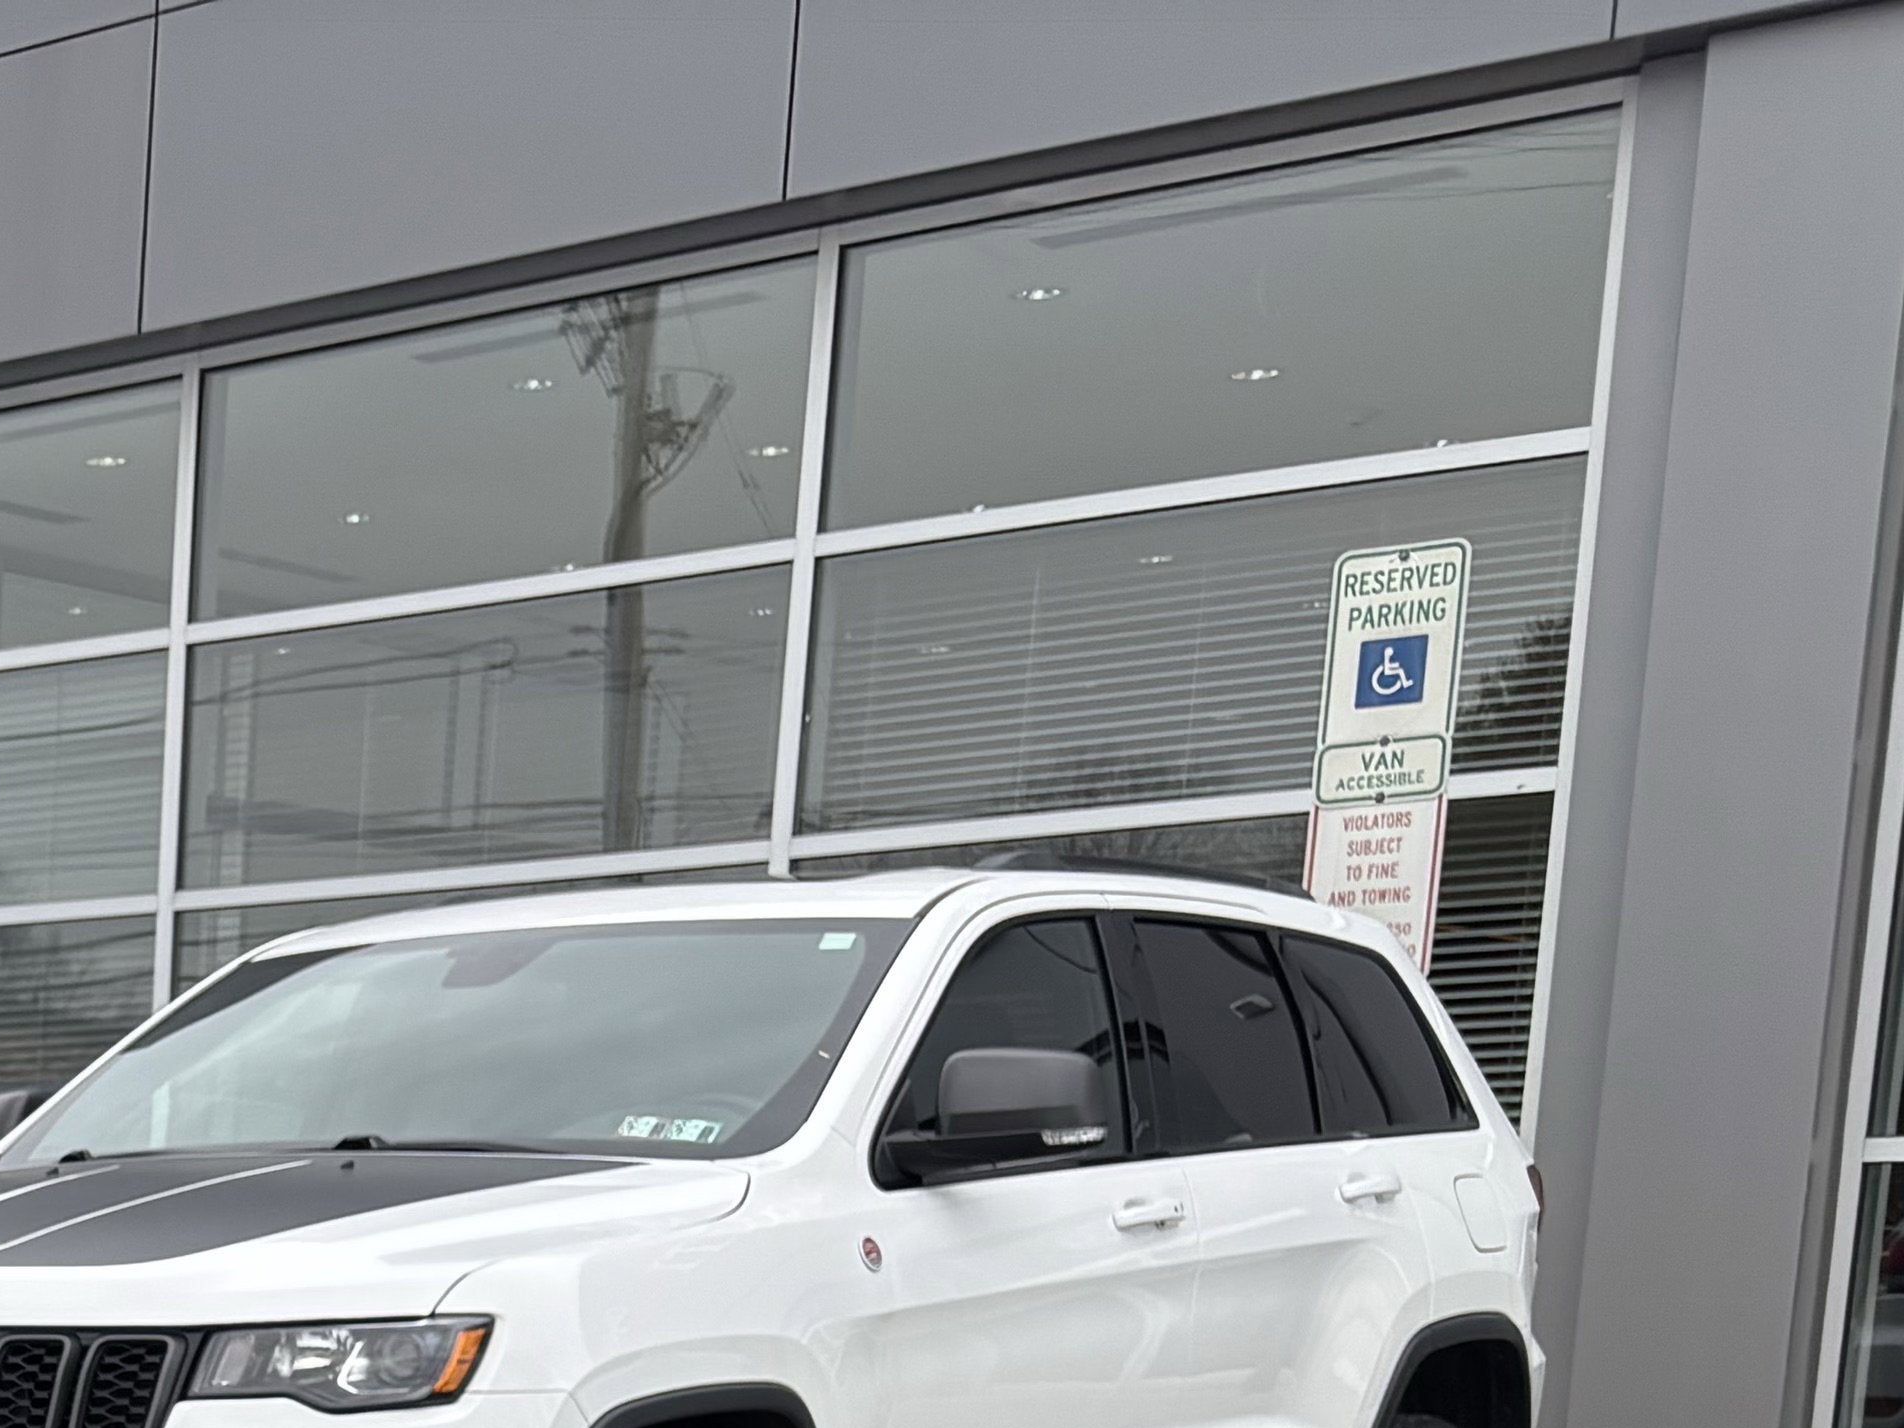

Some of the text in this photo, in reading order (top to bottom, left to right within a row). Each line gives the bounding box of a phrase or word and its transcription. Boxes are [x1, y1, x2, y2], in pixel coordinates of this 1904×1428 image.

[1344, 562, 1457, 598] RESERVED
[1348, 597, 1446, 631] PARKING
[1361, 749, 1405, 772] VAN
[1335, 769, 1424, 792] ACCESSIBLE
[1343, 811, 1412, 832] VIOLATORS
[1346, 837, 1402, 857] SUBJECT
[1346, 862, 1399, 882] TO FINE
[1328, 886, 1411, 908] AND TOWING
